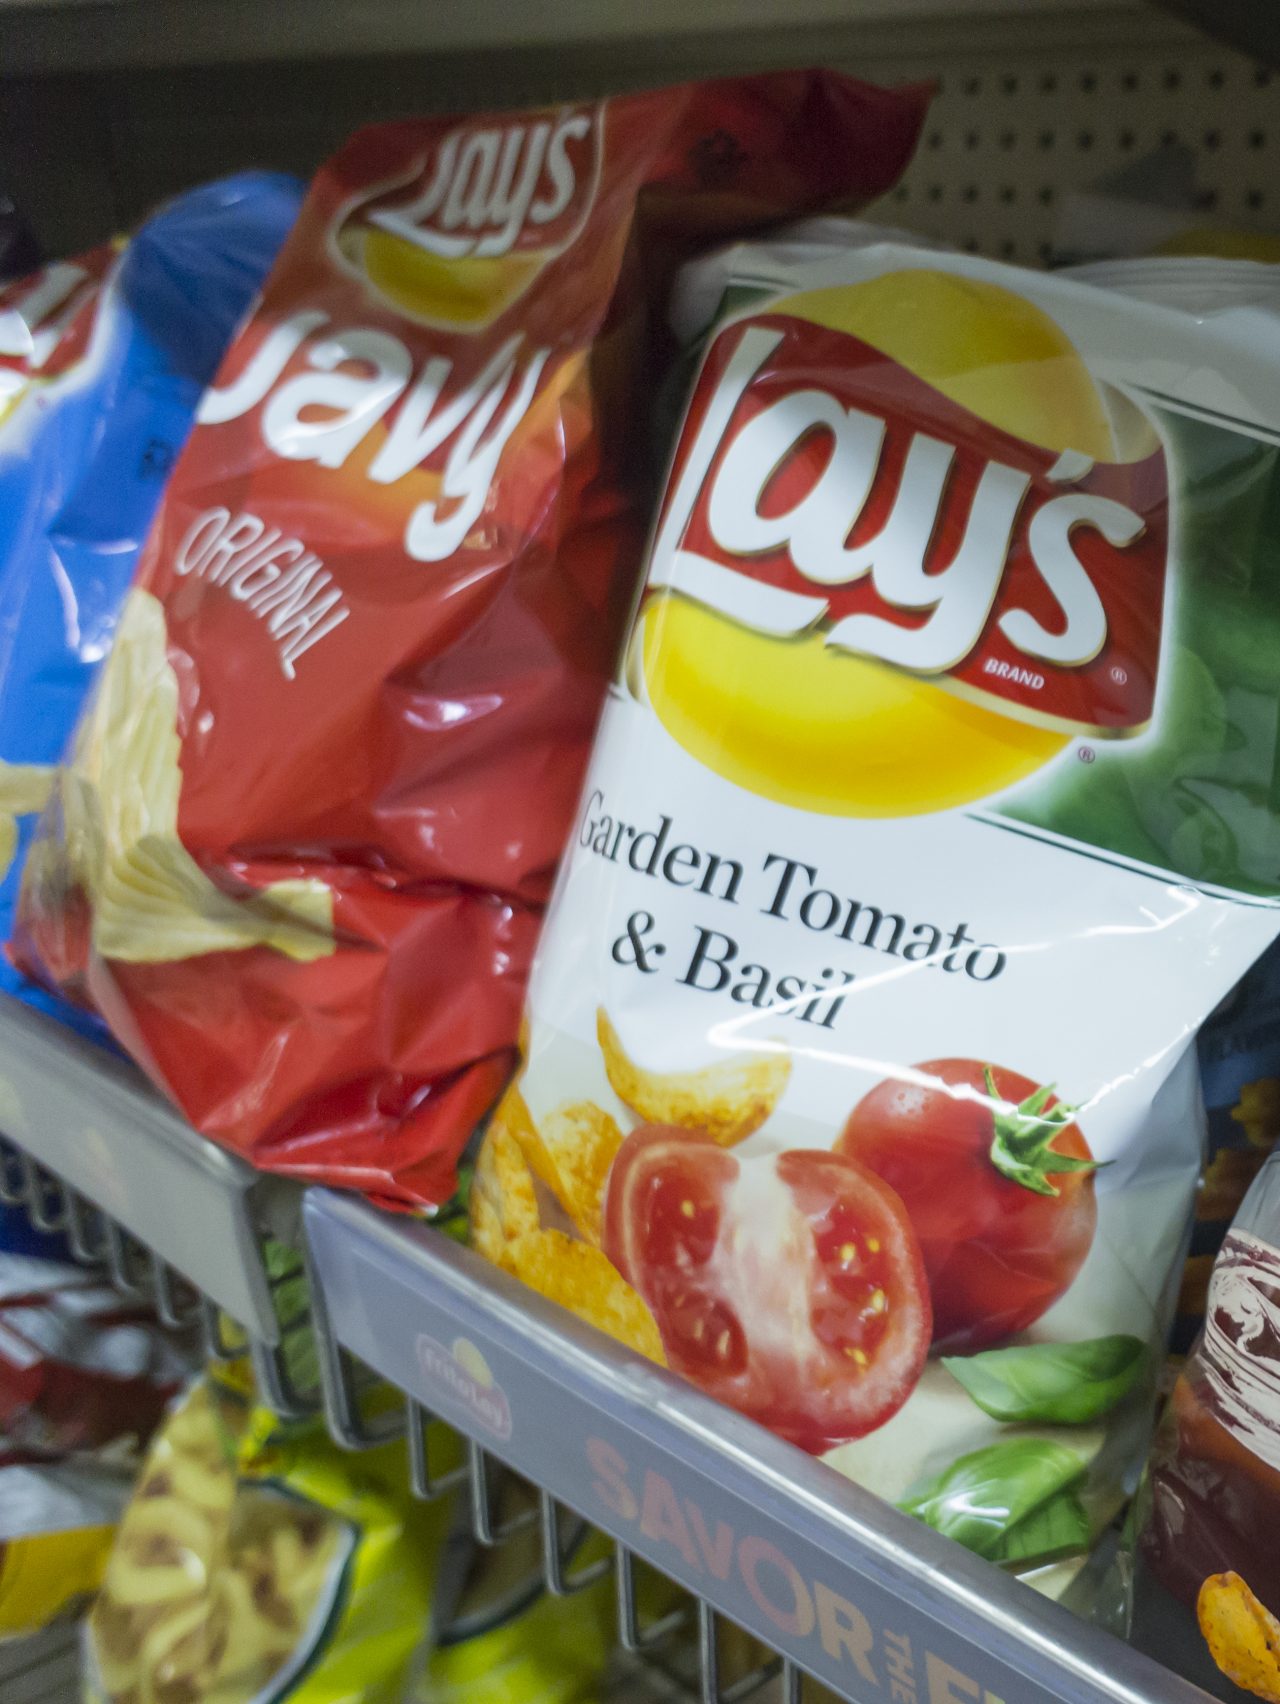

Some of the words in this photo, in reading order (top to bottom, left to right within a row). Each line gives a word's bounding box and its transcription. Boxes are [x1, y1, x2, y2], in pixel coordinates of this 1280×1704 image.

[646, 326, 1147, 674] Lay's
[174, 506, 350, 681] ORIGINAL
[983, 656, 1046, 691] BRAND
[579, 790, 744, 905] Garden
[758, 852, 1007, 983] Tomato
[610, 909, 667, 975] &
[676, 924, 857, 1030] Basil
[584, 1433, 880, 1688] SAVOR
